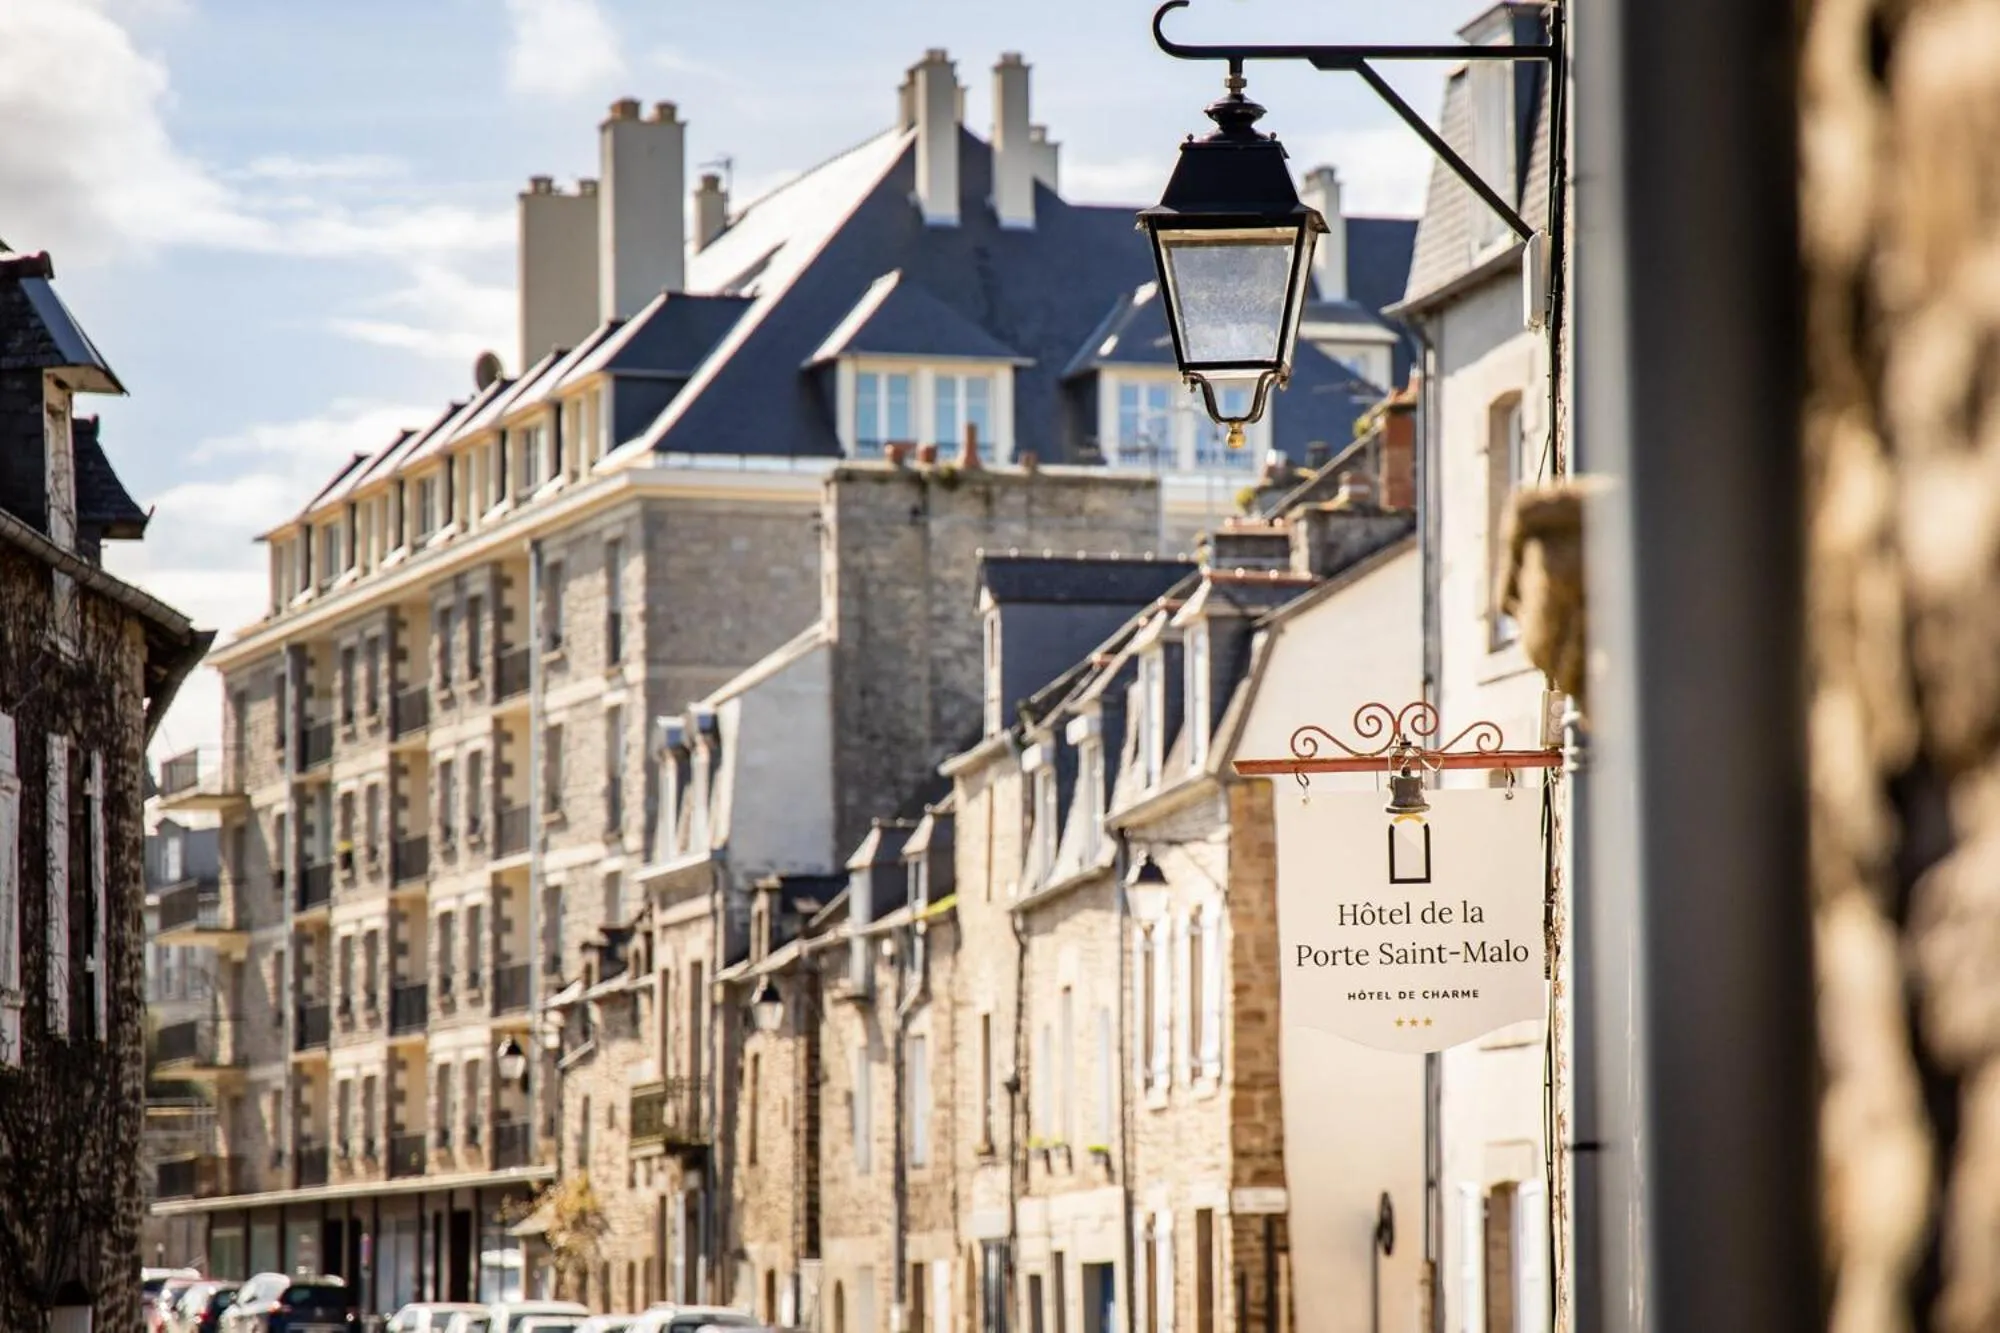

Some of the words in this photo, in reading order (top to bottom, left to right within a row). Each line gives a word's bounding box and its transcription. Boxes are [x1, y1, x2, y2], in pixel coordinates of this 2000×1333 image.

[1338, 900, 1411, 926] Hôtel
[1420, 900, 1453, 925] de
[1461, 899, 1485, 924] la
[1296, 943, 1370, 967] Porte
[1379, 939, 1529, 965] Saint-Malo
[1347, 988, 1392, 1001] HÔTEL
[1398, 990, 1416, 1000] DE
[1422, 989, 1480, 1000] CHARME
